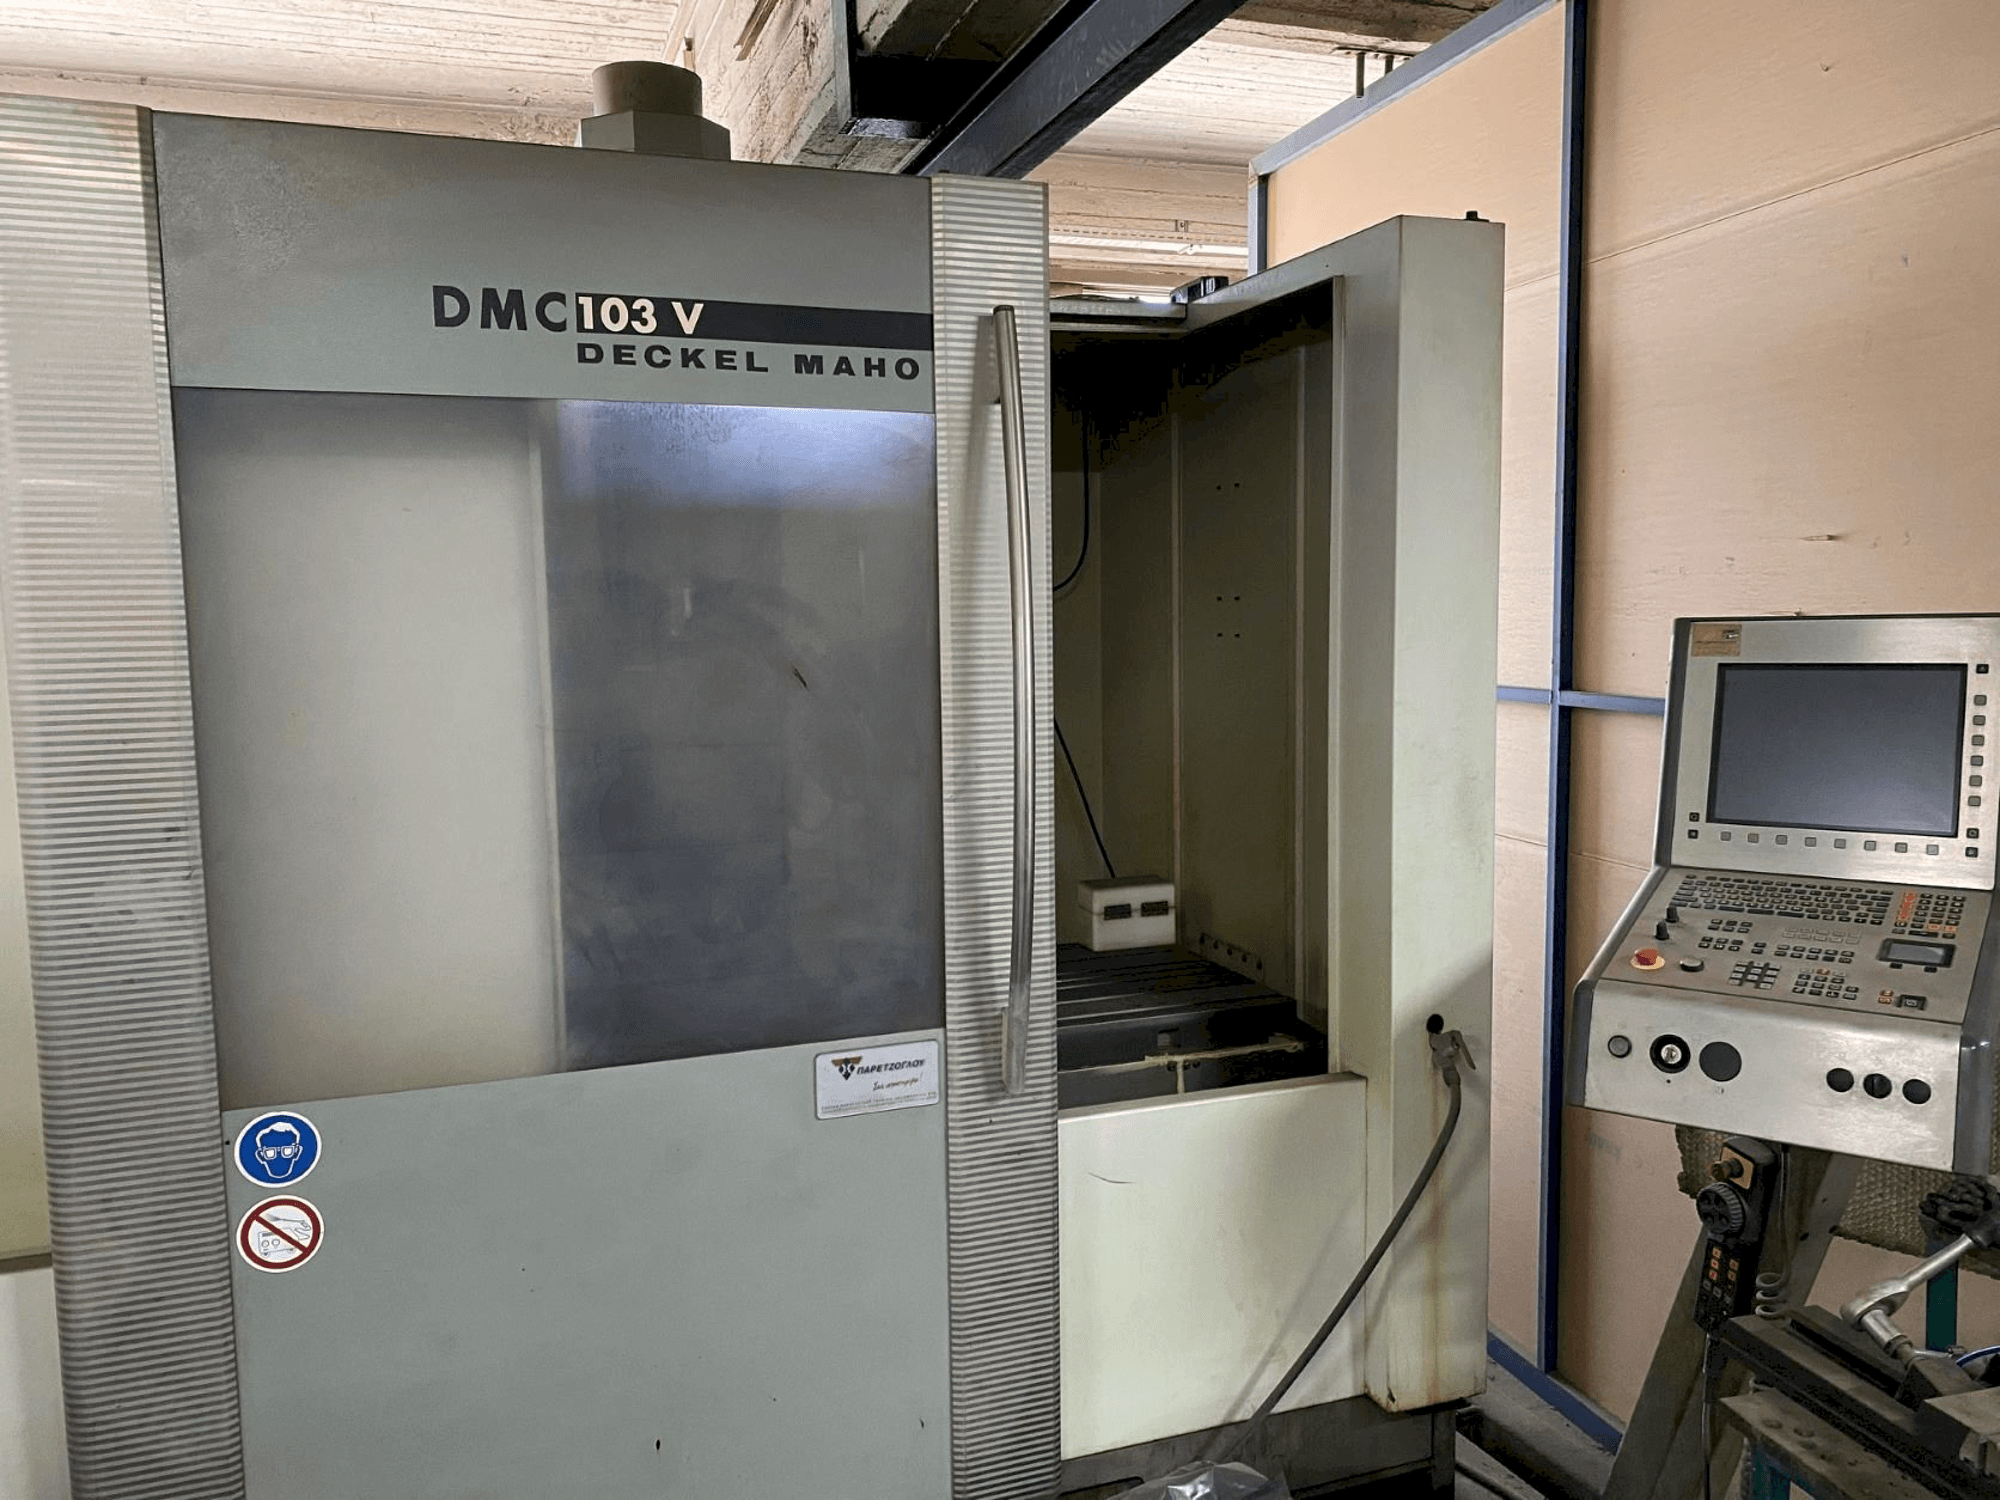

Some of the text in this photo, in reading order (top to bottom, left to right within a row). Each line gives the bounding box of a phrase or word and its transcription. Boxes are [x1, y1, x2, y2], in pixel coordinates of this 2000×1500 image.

[433, 285, 704, 335] DMC 103 V
[577, 342, 920, 381] DECKEL MAHO
[856, 1058, 925, 1075] ΠΑΡΕΤΖΟΓΛΟΥ
